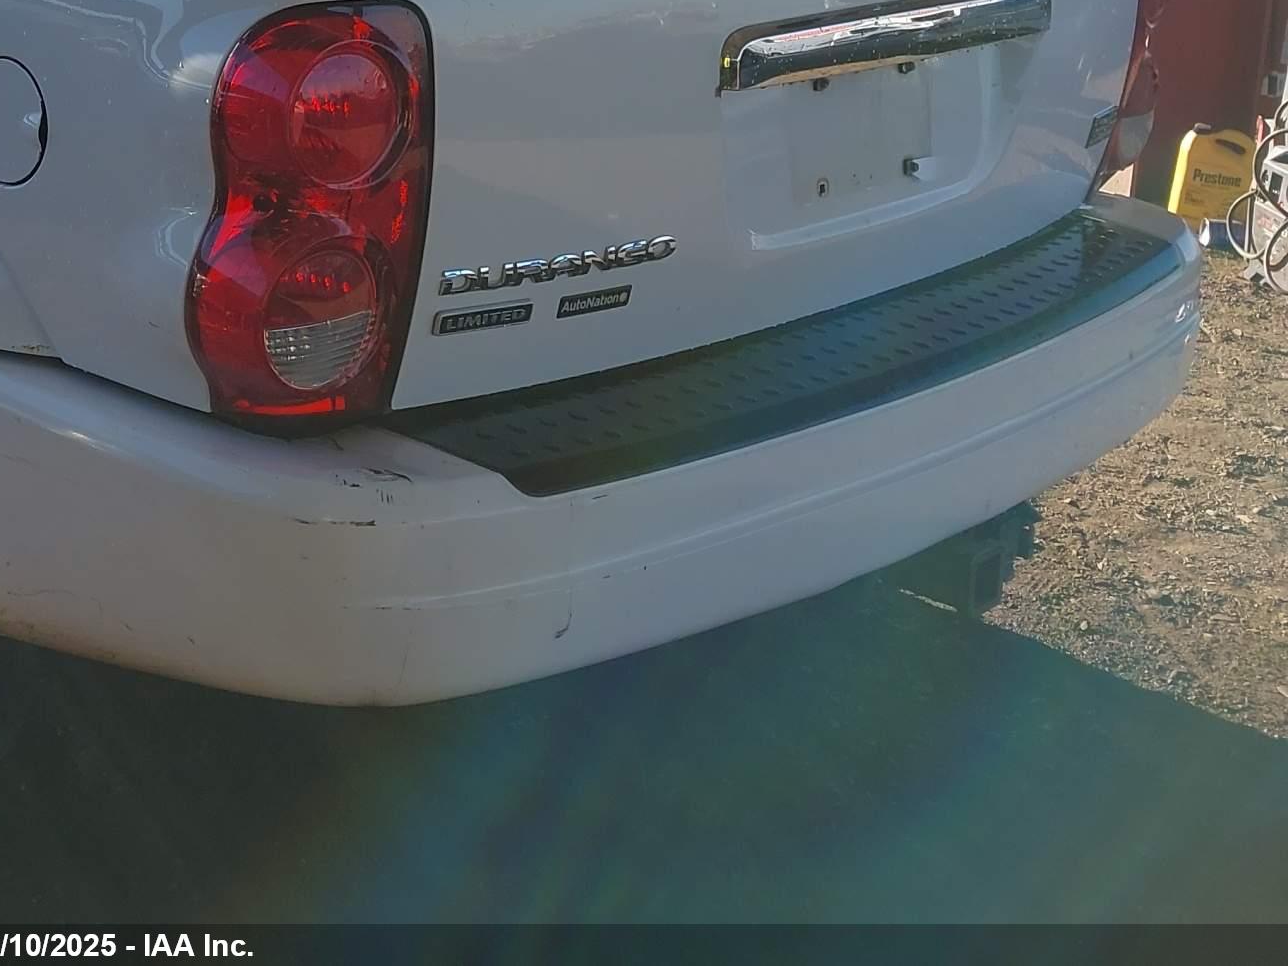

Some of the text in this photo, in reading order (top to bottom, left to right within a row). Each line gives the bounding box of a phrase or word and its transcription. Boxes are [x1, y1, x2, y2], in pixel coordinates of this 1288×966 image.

[1193, 168, 1242, 187] Prestone
[439, 234, 677, 295] DURANGO
[561, 292, 620, 314] AutoNation
[445, 308, 527, 331] LIMITED
